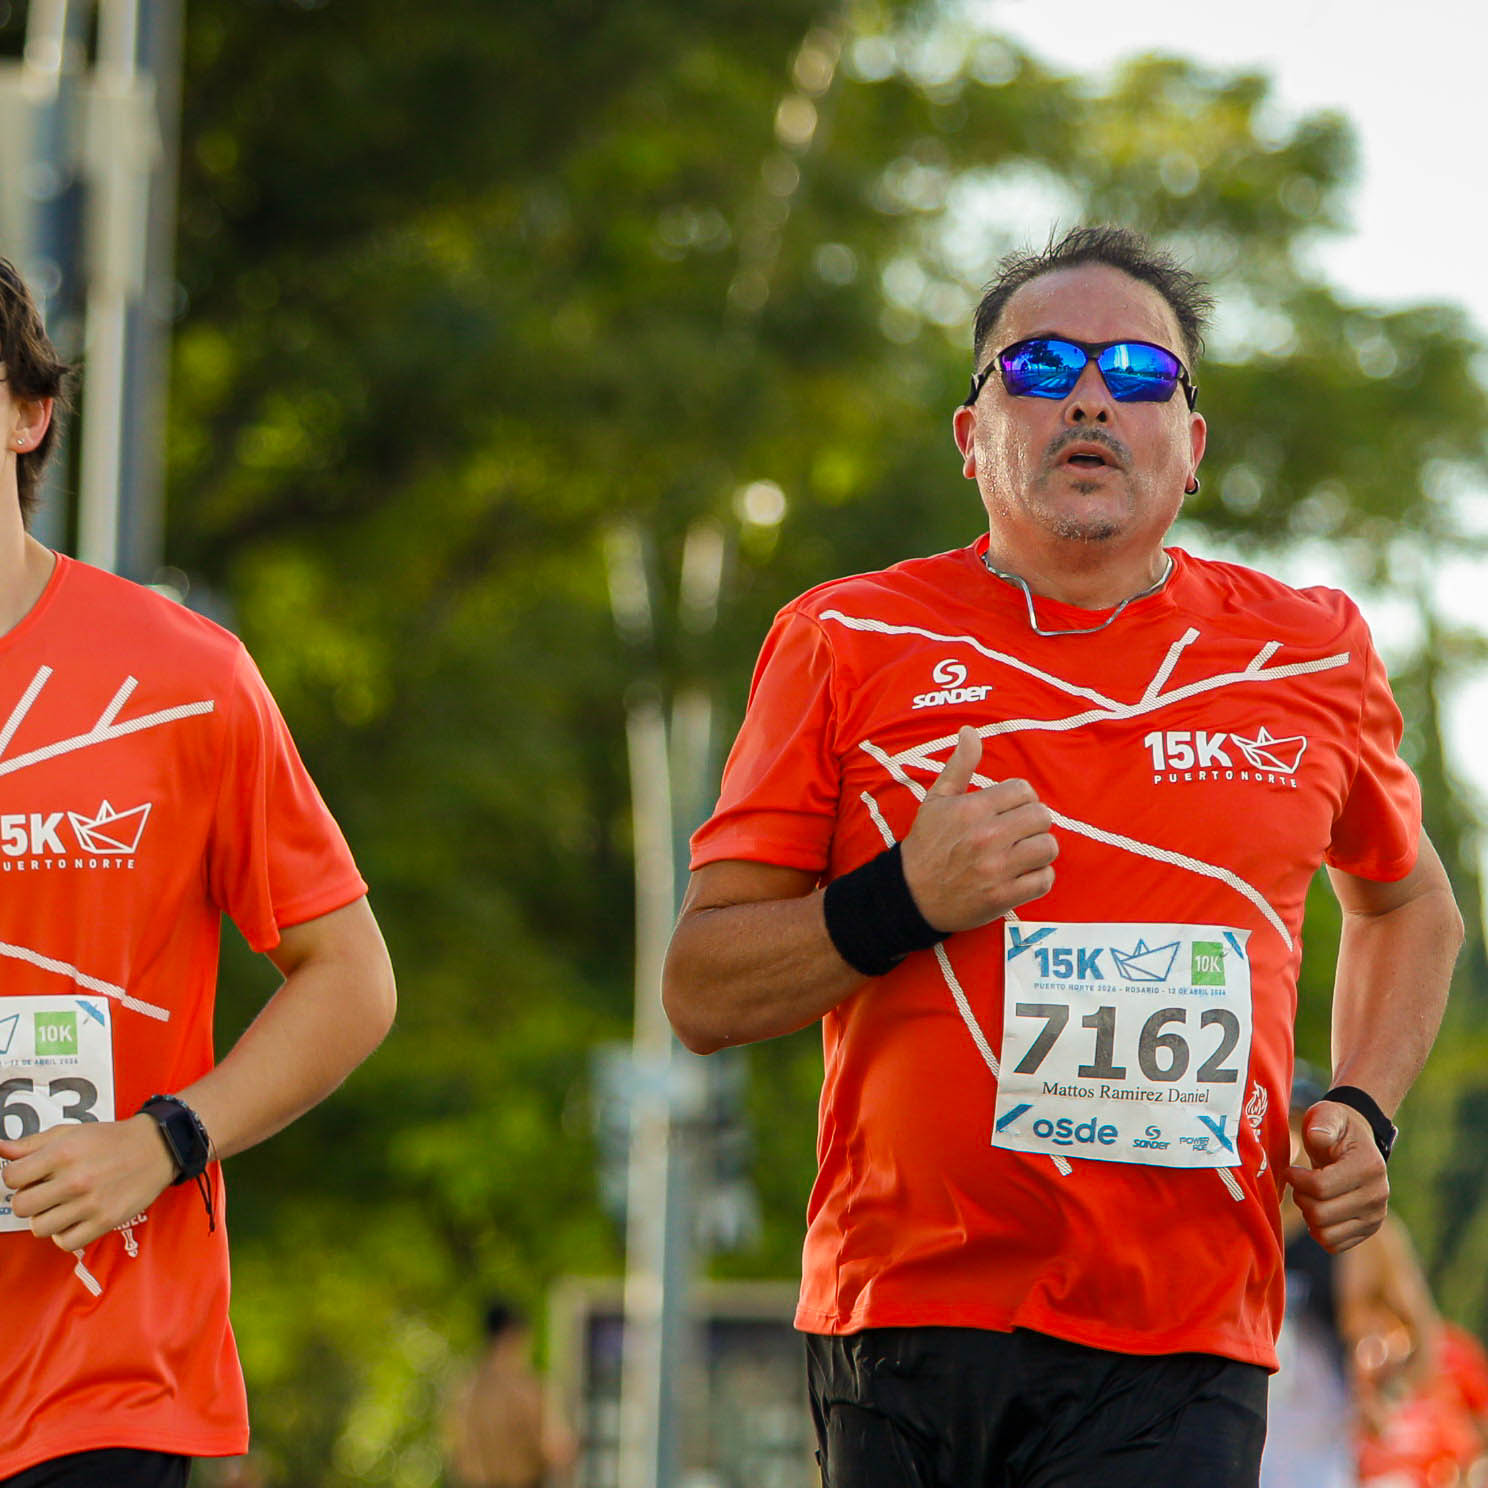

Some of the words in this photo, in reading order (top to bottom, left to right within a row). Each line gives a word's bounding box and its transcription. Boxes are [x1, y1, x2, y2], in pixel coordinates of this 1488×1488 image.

[1144, 730, 1233, 771] 15K
[1034, 947, 1105, 980] 15K
[1195, 955, 1222, 973] 10K
[1034, 983, 1066, 991] PUERTO
[1068, 984, 1094, 992] NORTE
[1125, 986, 1160, 994] ROSARIO
[38, 1025, 73, 1043] 10K
[1014, 1002, 1241, 1084] 7162
[1042, 1081, 1095, 1099] Mattos
[1099, 1084, 1163, 1102] Ramirez
[1167, 1088, 1210, 1103] Daniel
[1033, 1116, 1119, 1145] osde
